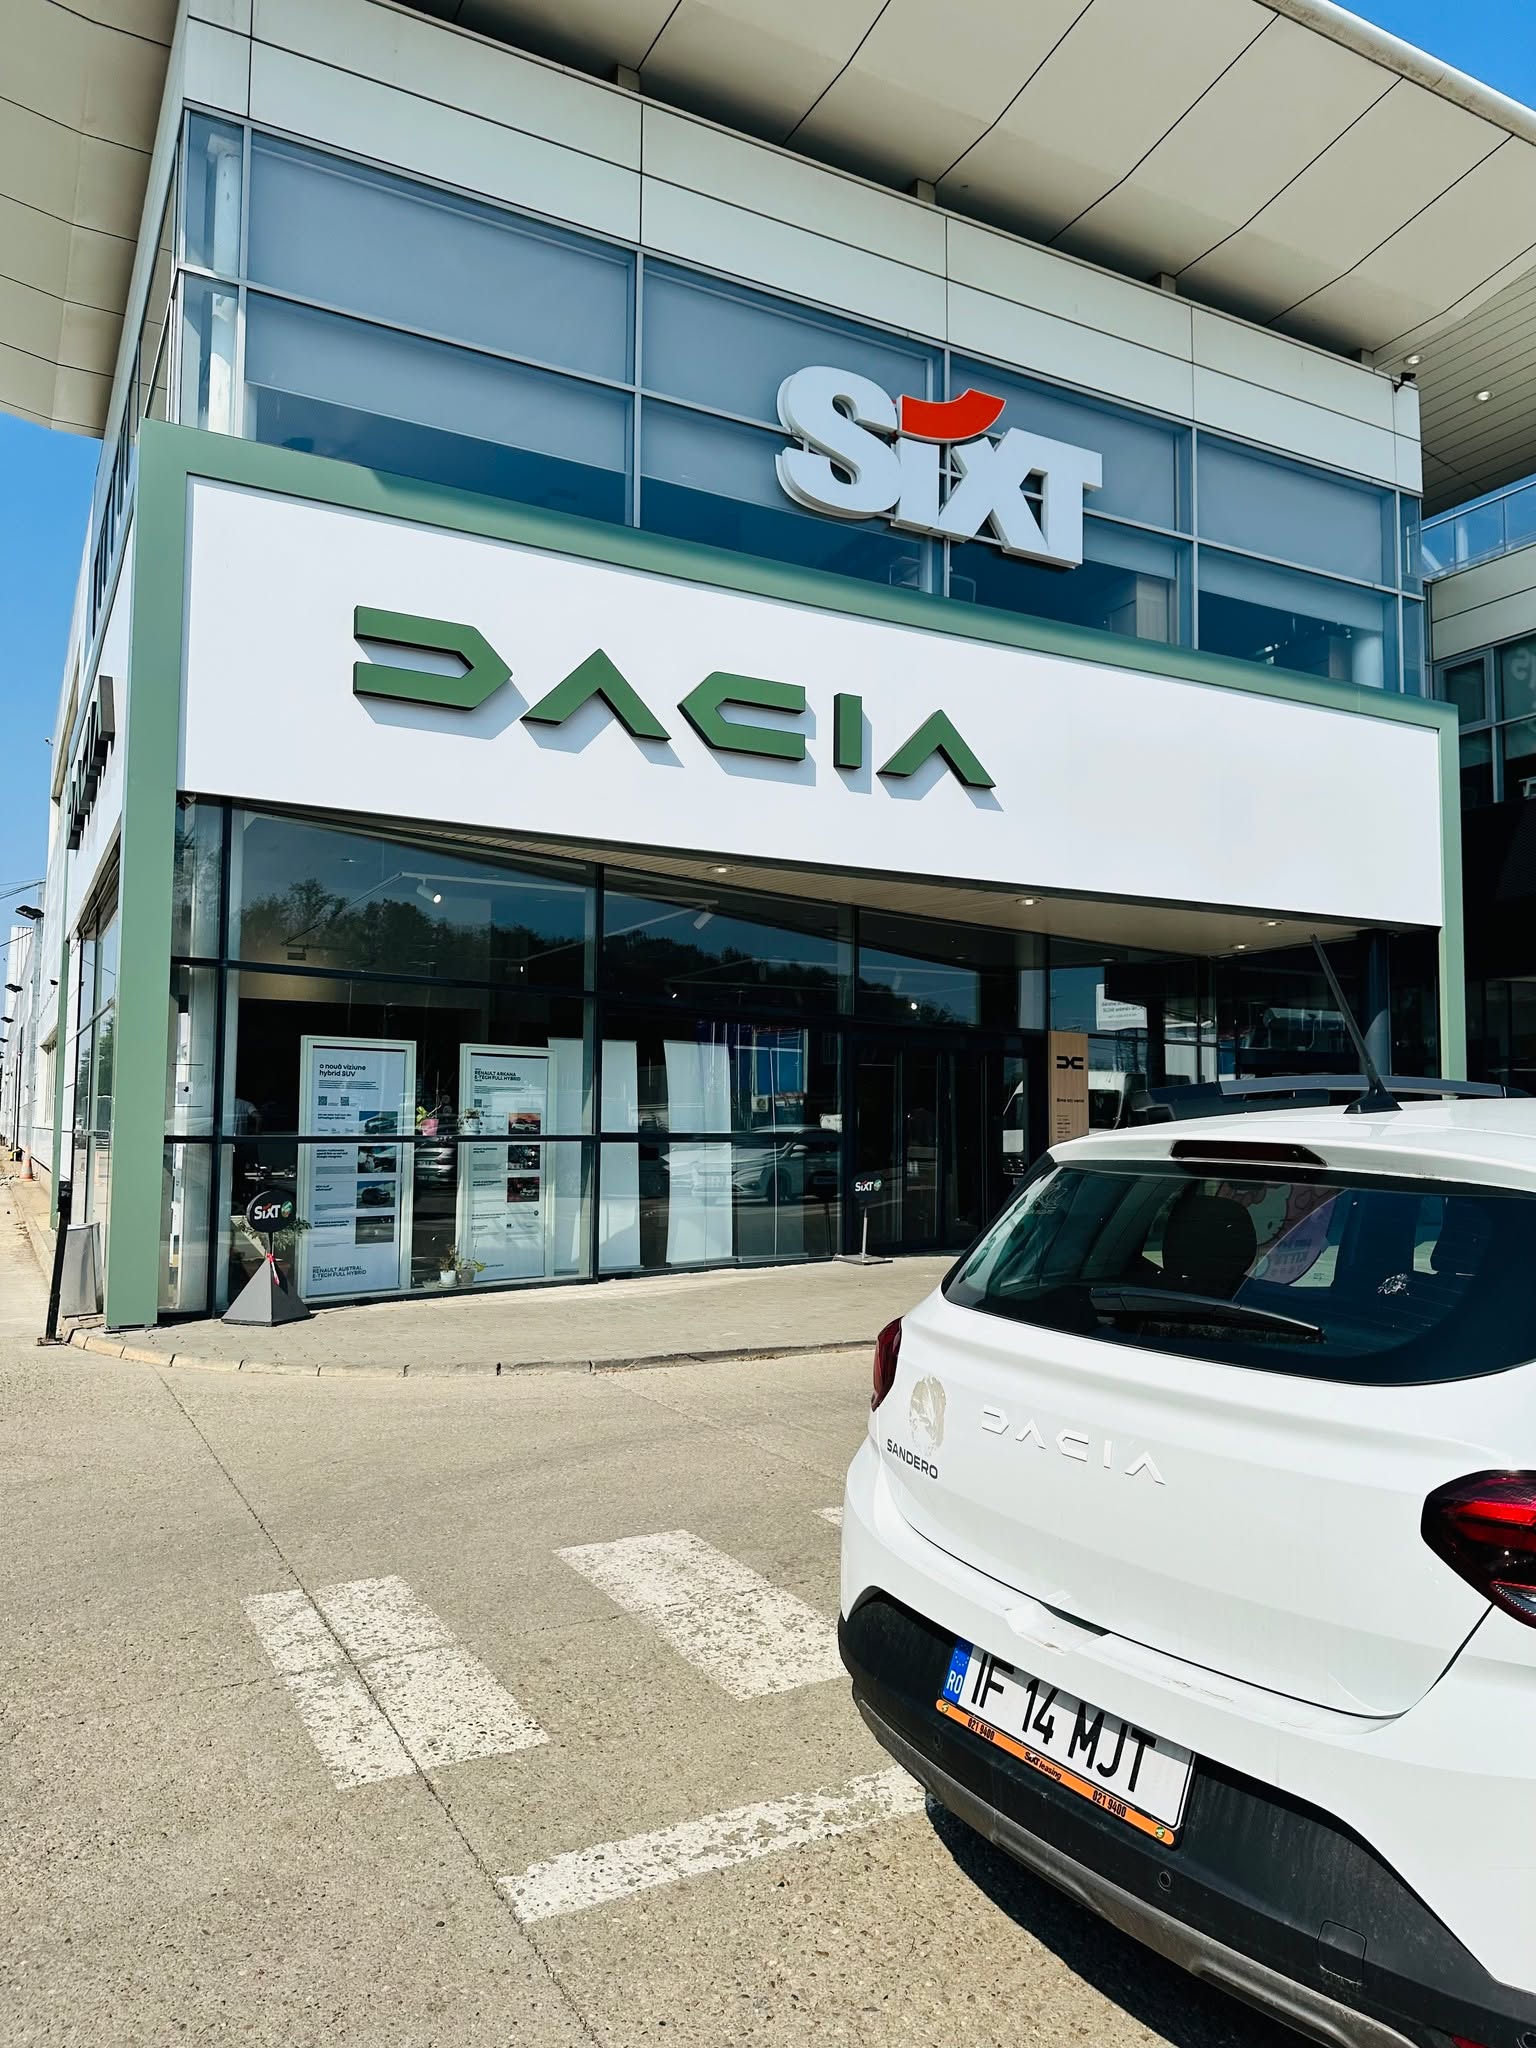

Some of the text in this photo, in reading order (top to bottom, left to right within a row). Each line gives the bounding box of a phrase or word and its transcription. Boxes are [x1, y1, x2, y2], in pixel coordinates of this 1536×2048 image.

[353, 605, 997, 790] DACIA
[319, 1069, 341, 1077] hybrid
[343, 1063, 366, 1071] viziune
[981, 1404, 1166, 1486] DACIA
[886, 1438, 939, 1480] SANDERO
[946, 1669, 964, 1695] RO
[967, 1717, 995, 1741] 021 9400
[971, 1652, 1157, 1793] IF 14 MJT
[1039, 1761, 1062, 1781] leasing
[1092, 1790, 1127, 1818] 021 9400
